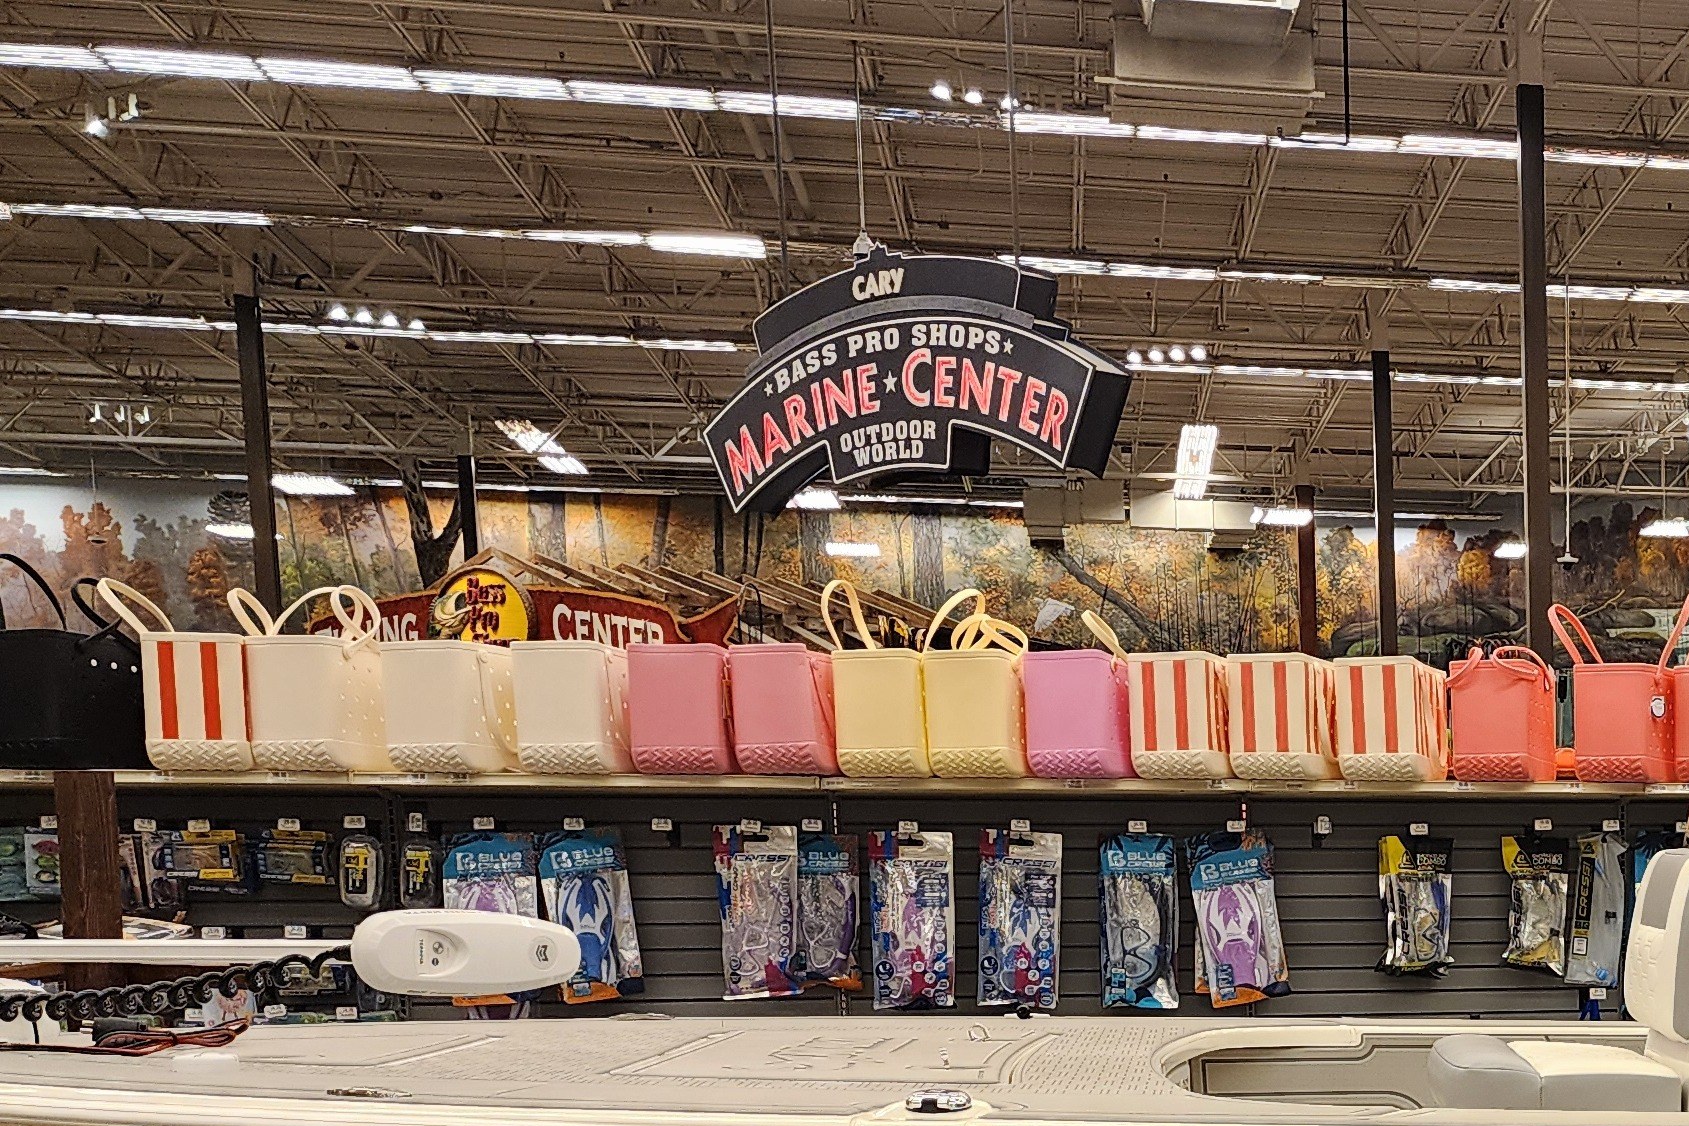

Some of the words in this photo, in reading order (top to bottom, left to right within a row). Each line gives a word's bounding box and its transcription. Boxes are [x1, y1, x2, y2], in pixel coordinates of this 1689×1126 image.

[852, 267, 905, 301] CARY
[775, 343, 839, 395] BASS
[847, 326, 900, 360] PRO
[911, 323, 1002, 356] SHOPS
[724, 362, 881, 497] MARINE
[901, 347, 1070, 452] CENTER
[840, 419, 936, 454] OUTDOOR
[853, 439, 924, 468] WORLD
[1003, 858, 1057, 868] CRESSI
[1579, 861, 1592, 918] CRESSI
